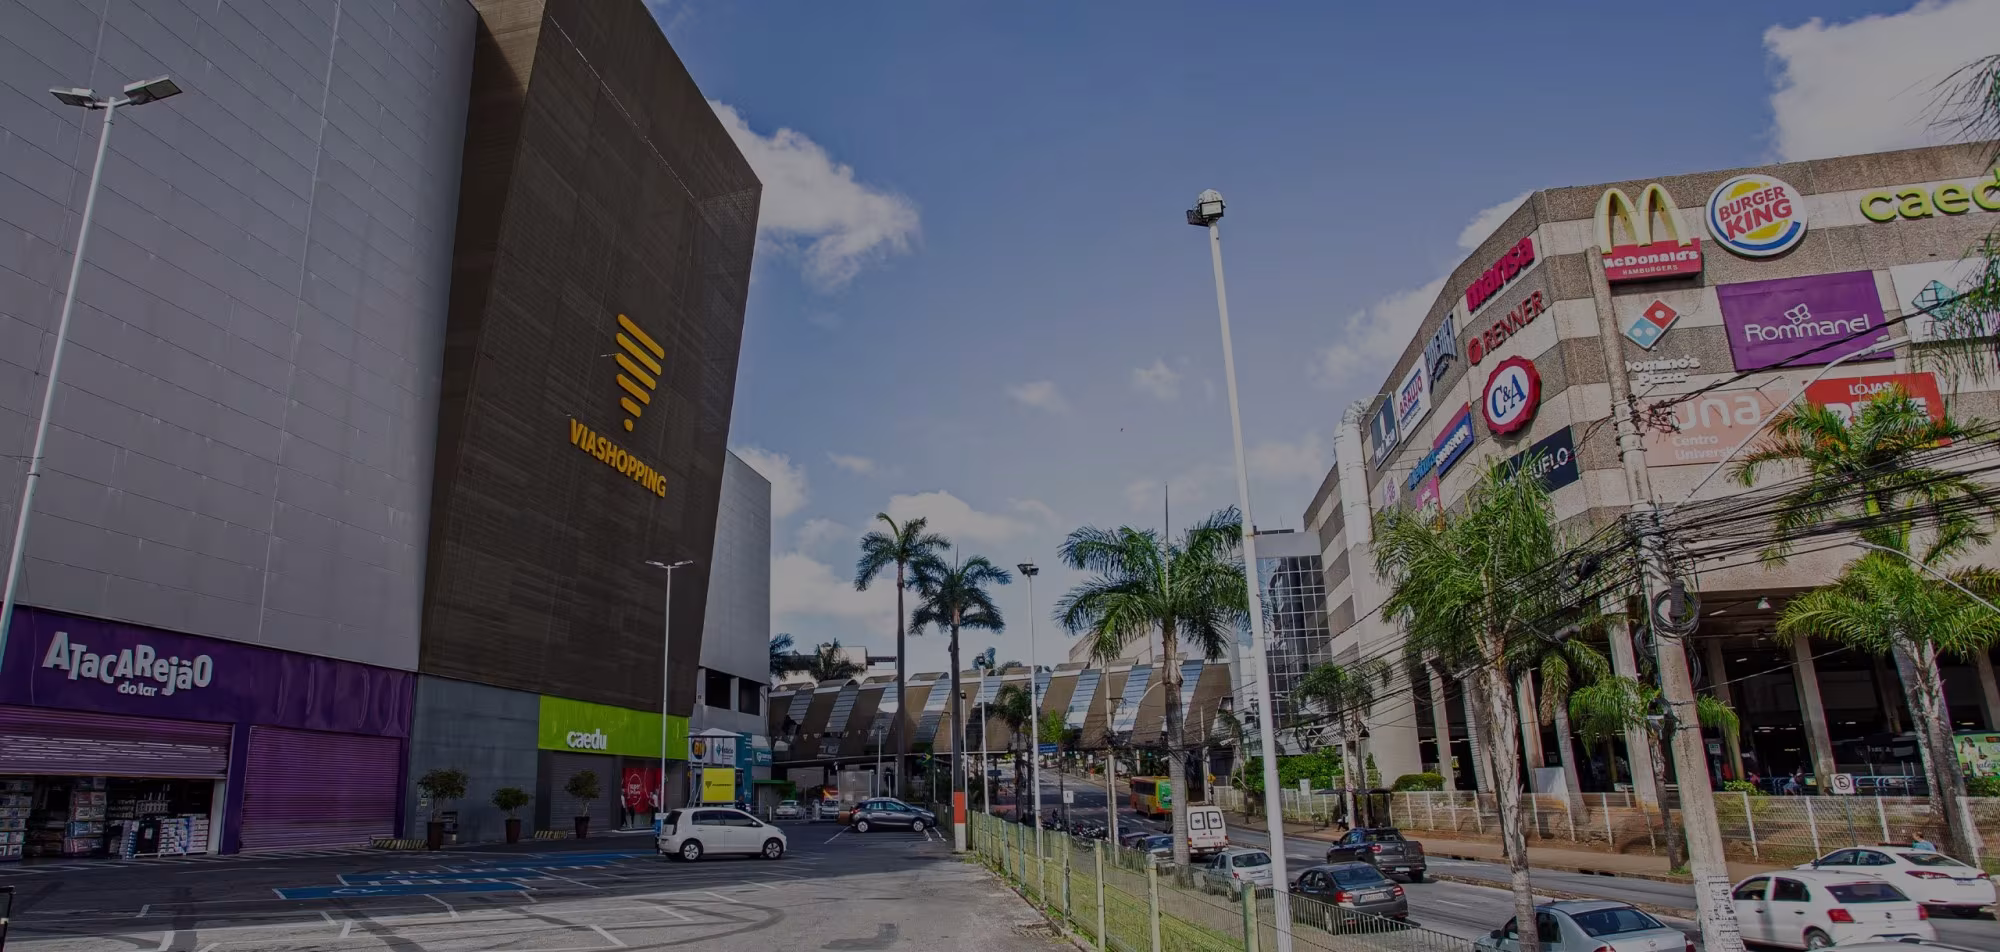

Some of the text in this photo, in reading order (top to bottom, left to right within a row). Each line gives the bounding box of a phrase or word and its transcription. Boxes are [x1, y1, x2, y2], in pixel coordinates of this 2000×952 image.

[1719, 186, 1787, 221] BURGER
[1724, 198, 1794, 241] KING
[1465, 236, 1536, 313] marisa
[1603, 250, 1700, 269] McDonald's
[1622, 264, 1679, 276] HAMBURGERS
[1482, 290, 1545, 355] RENNER
[1744, 313, 1871, 344] Rommanel
[1399, 374, 1423, 417] ARAUJO
[1491, 373, 1527, 419] C&A
[1848, 381, 1894, 396] LOJAS
[1672, 434, 1719, 447] Centro
[569, 417, 668, 499] VIASHOPPING
[117, 681, 158, 698] do lar
[566, 728, 608, 751] caedu
